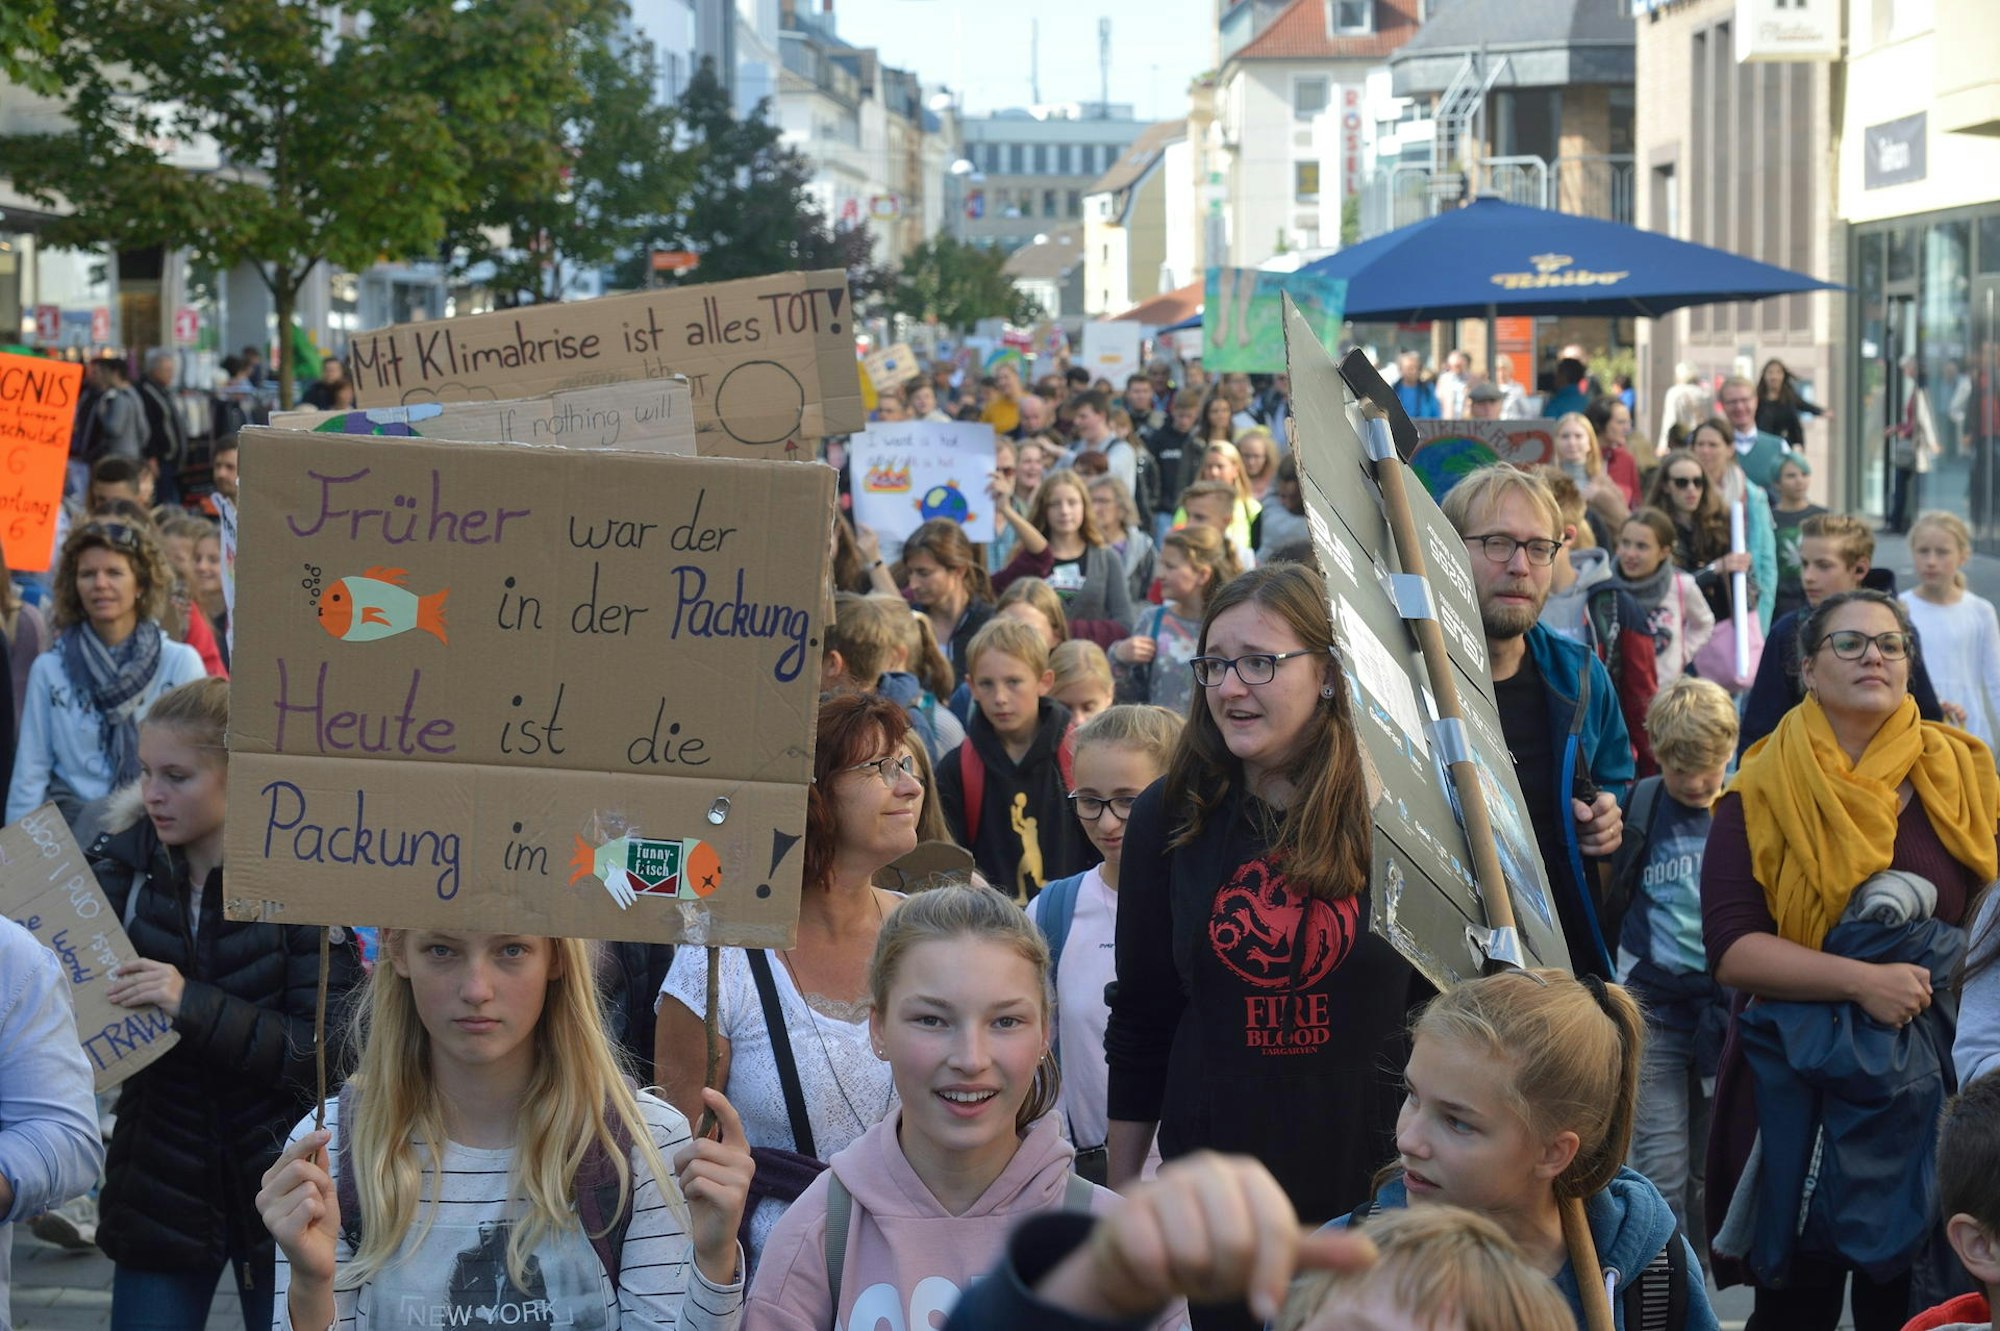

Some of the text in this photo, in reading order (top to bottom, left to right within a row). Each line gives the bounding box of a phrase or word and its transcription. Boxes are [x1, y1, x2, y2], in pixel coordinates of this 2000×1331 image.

[352, 287, 845, 391] Mit Klimakrise ist alles TOT!
[499, 393, 672, 446] If nothing will
[286, 466, 531, 545] Früher
[569, 515, 658, 551] war
[670, 489, 738, 552] der
[497, 561, 820, 683] in der Packung.
[273, 657, 712, 766] Heute ist die
[260, 780, 462, 901] Packung
[503, 820, 549, 877] im
[636, 843, 675, 862] funny-
[635, 859, 670, 877] fisch
[1243, 993, 1330, 1028] FIRE
[1246, 1027, 1331, 1047] BLOOD
[406, 1298, 560, 1327] NEW YORK
